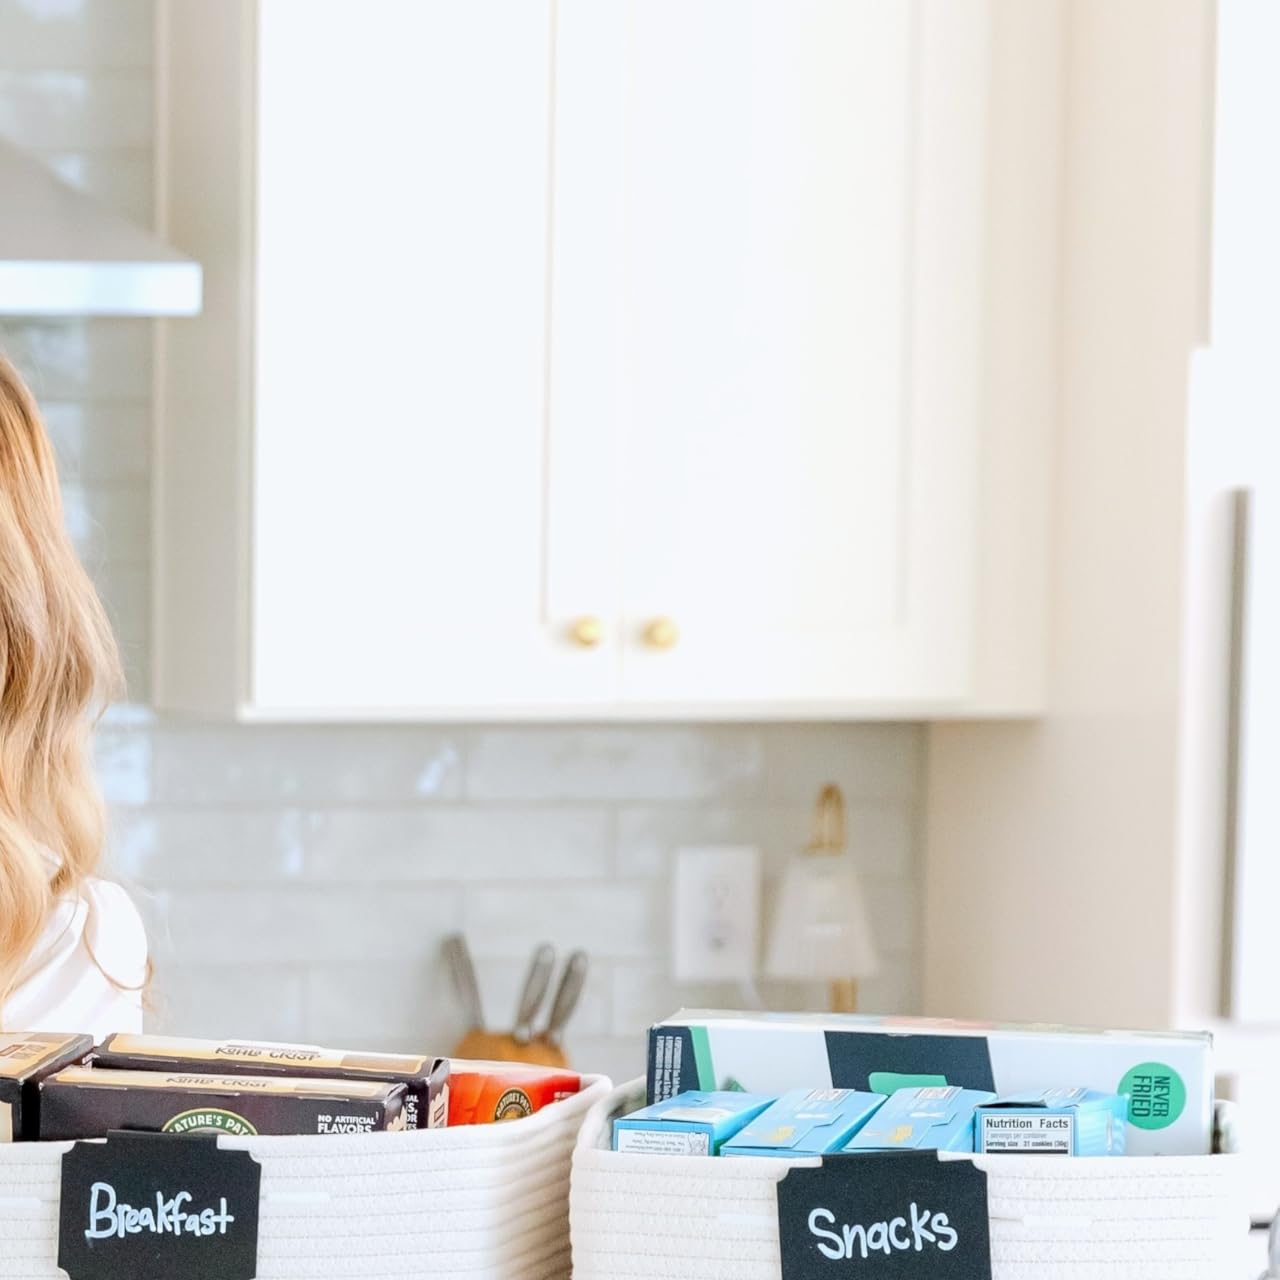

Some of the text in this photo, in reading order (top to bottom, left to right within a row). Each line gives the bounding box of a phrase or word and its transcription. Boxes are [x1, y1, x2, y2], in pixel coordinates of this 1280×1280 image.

[1131, 1075, 1170, 1117] NEVER FRIED
[169, 1114, 252, 1136] ATURE'S PAT
[317, 1115, 376, 1125] NO ARTIFICIAL
[986, 1118, 1069, 1129] Nutrition Facts
[317, 1123, 373, 1134] FLAVORS
[986, 1140, 1006, 1148] Serving
[84, 1181, 235, 1239] Breakfast
[807, 1202, 959, 1260] Snacks
